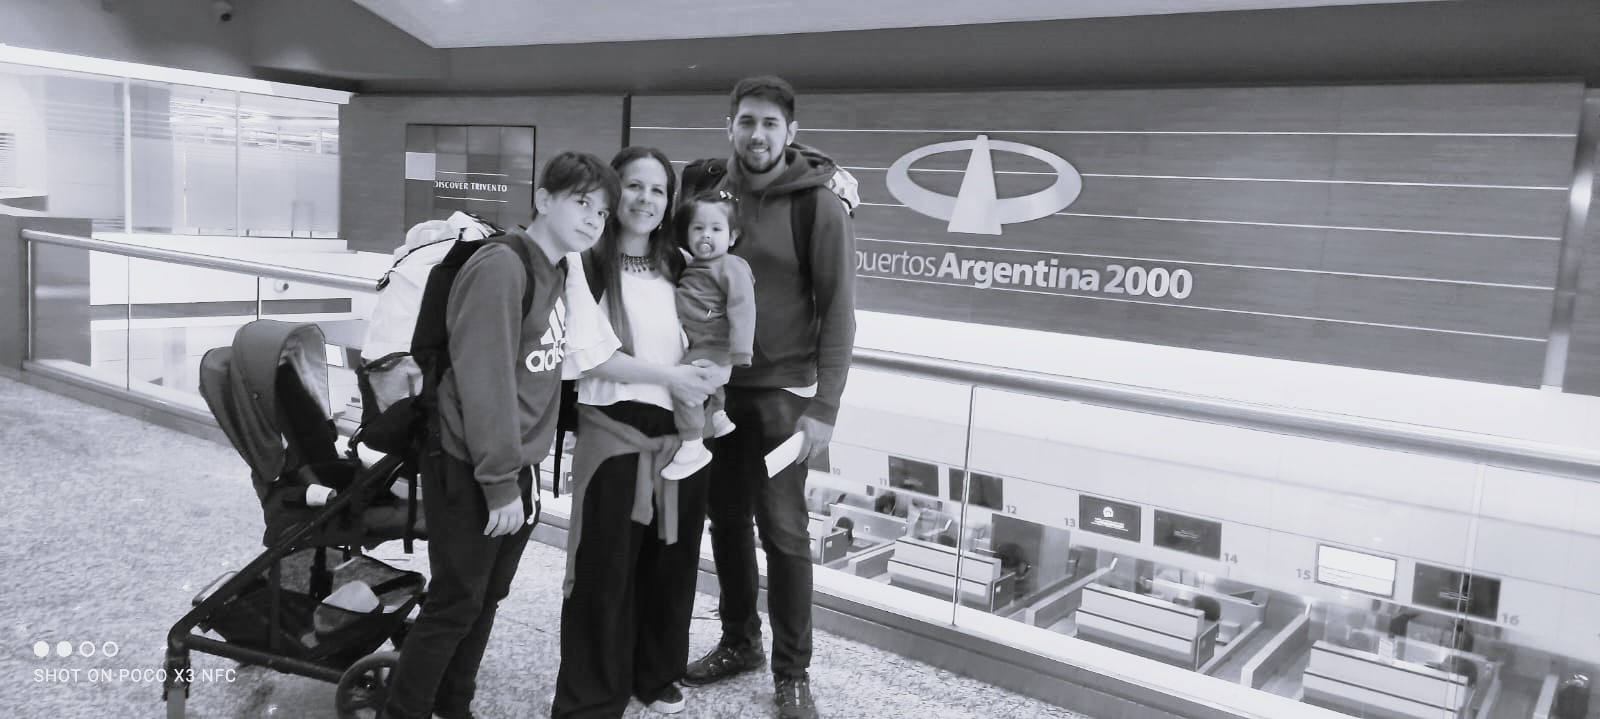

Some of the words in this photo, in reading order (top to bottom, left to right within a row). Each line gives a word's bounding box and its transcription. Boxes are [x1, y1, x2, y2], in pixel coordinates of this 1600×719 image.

[471, 182, 508, 192] TRIVENTO
[936, 252, 1100, 291] Argentina
[1103, 264, 1193, 299] 2000
[832, 467, 841, 476] 10
[879, 477, 888, 487] 11
[1006, 505, 1017, 515] 12
[1064, 517, 1076, 528] 13
[1224, 553, 1238, 564] 14
[1296, 568, 1311, 580] 15
[1502, 613, 1519, 626] 16
